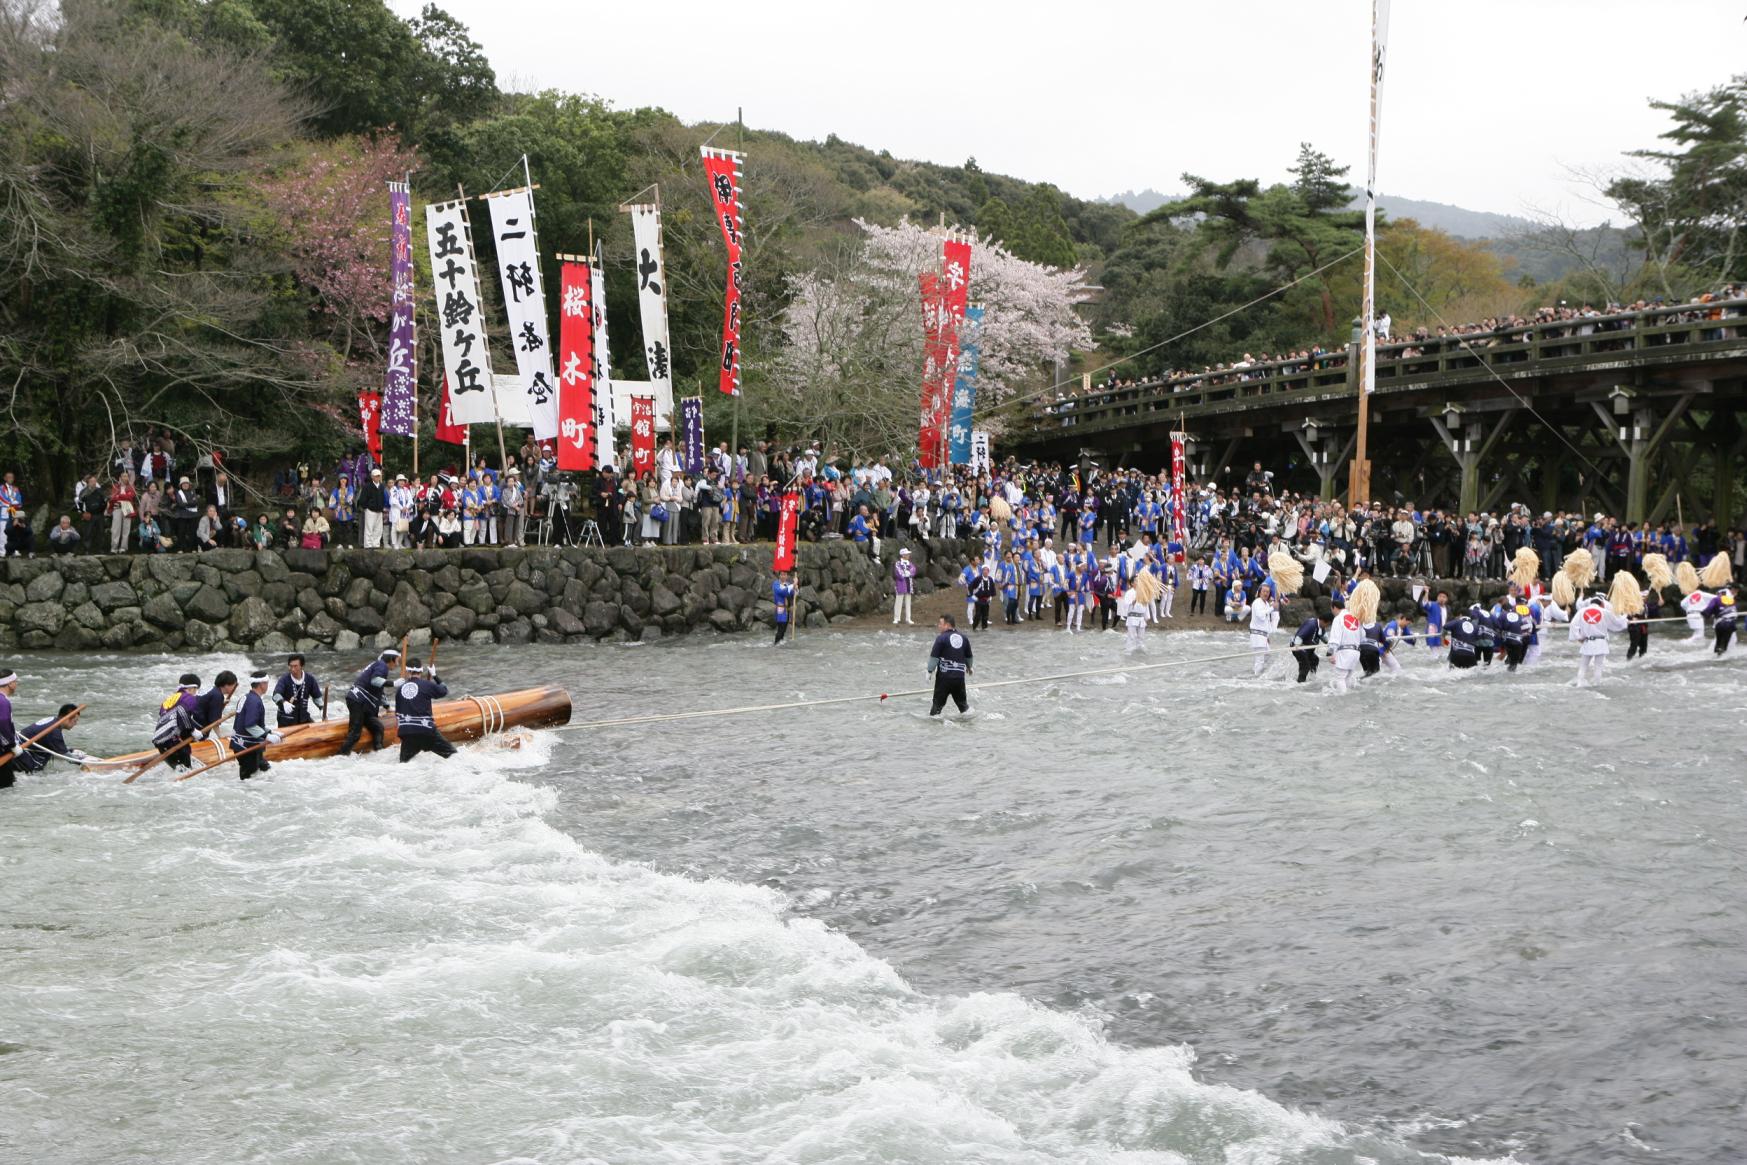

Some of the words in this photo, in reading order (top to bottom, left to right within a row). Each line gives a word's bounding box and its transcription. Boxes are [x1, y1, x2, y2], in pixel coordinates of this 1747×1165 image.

[638, 247, 669, 381] 大湊
[561, 284, 589, 450] 桜木町
[632, 401, 652, 417] 宇治
[633, 419, 651, 465] 館町
